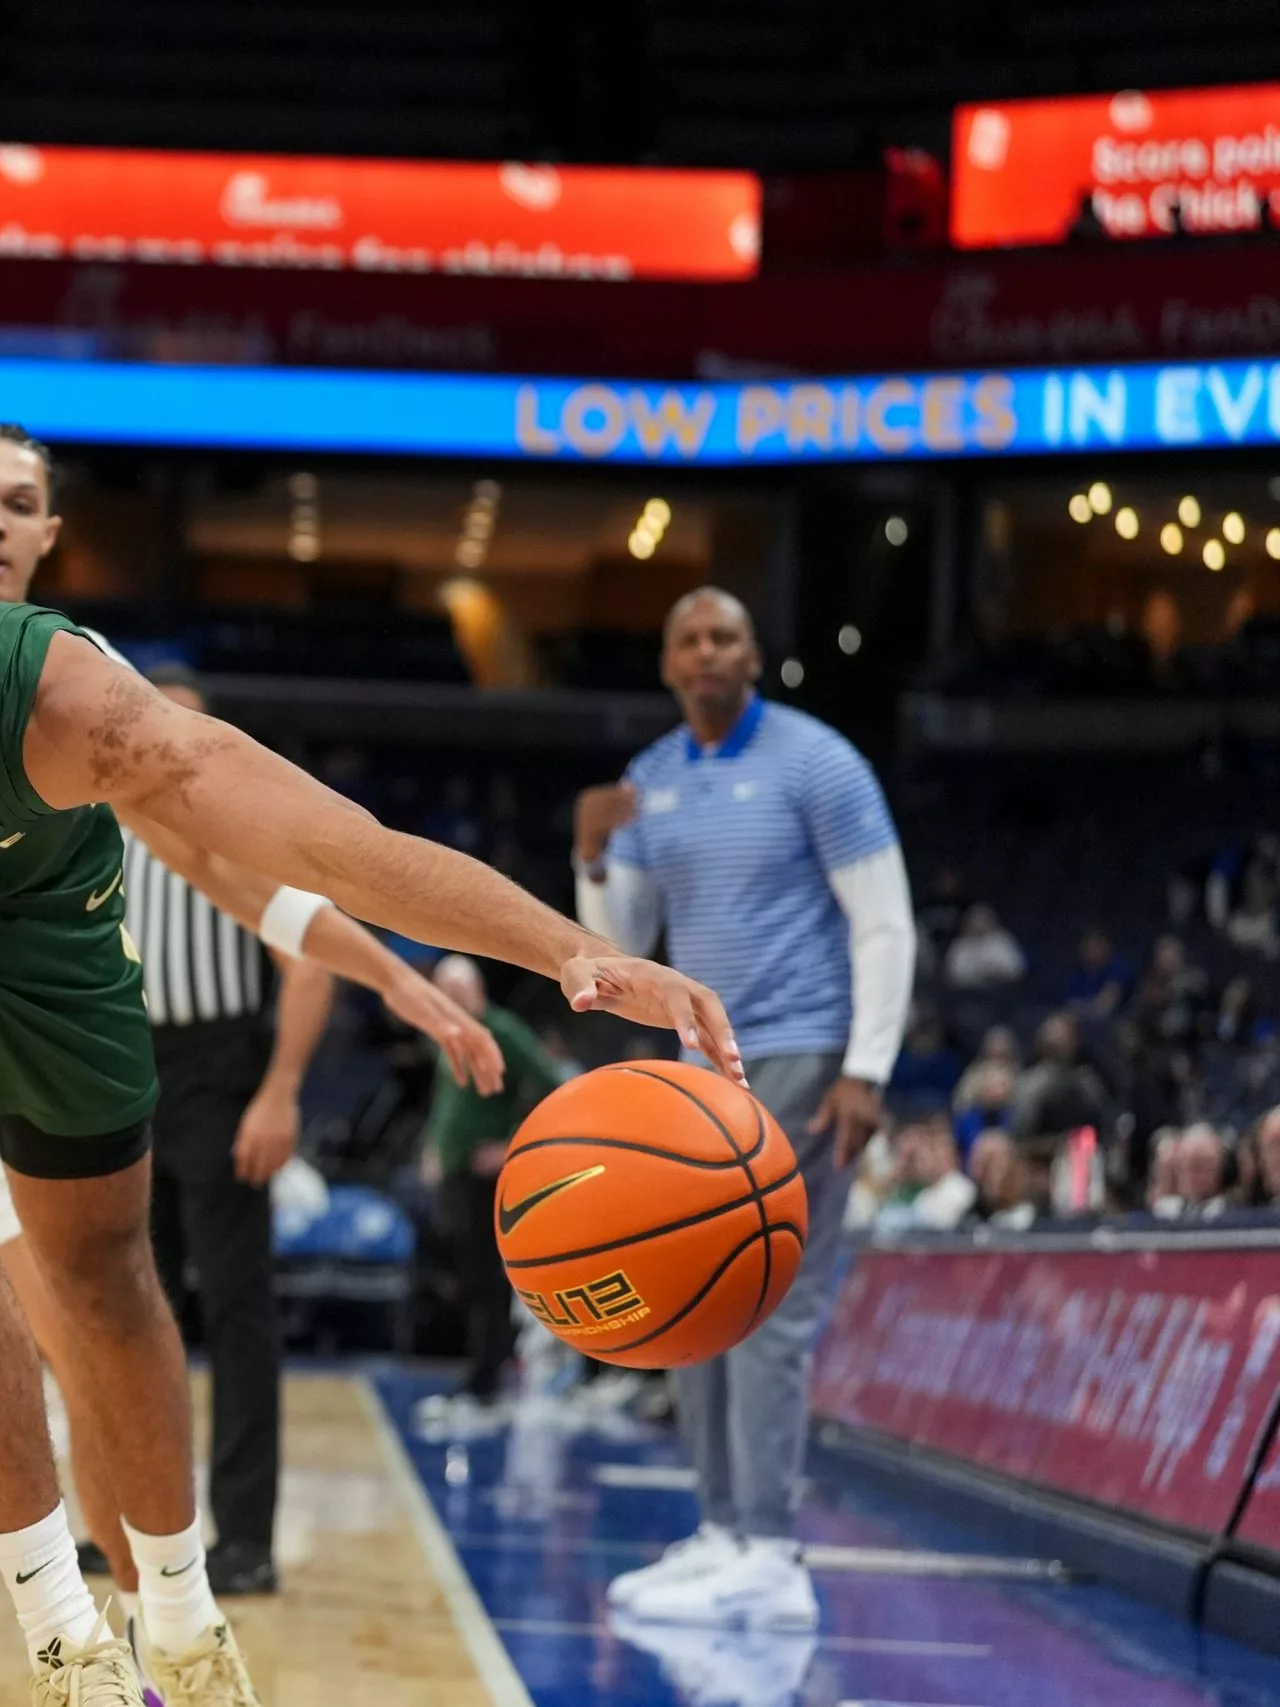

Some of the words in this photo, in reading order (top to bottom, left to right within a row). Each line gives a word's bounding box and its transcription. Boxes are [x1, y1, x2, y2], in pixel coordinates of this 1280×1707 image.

[516, 382, 716, 458] LOW
[737, 374, 1017, 454] PRICES
[1042, 371, 1127, 447] IN
[1155, 362, 1280, 444] EV
[517, 1269, 645, 1326] ELITE
